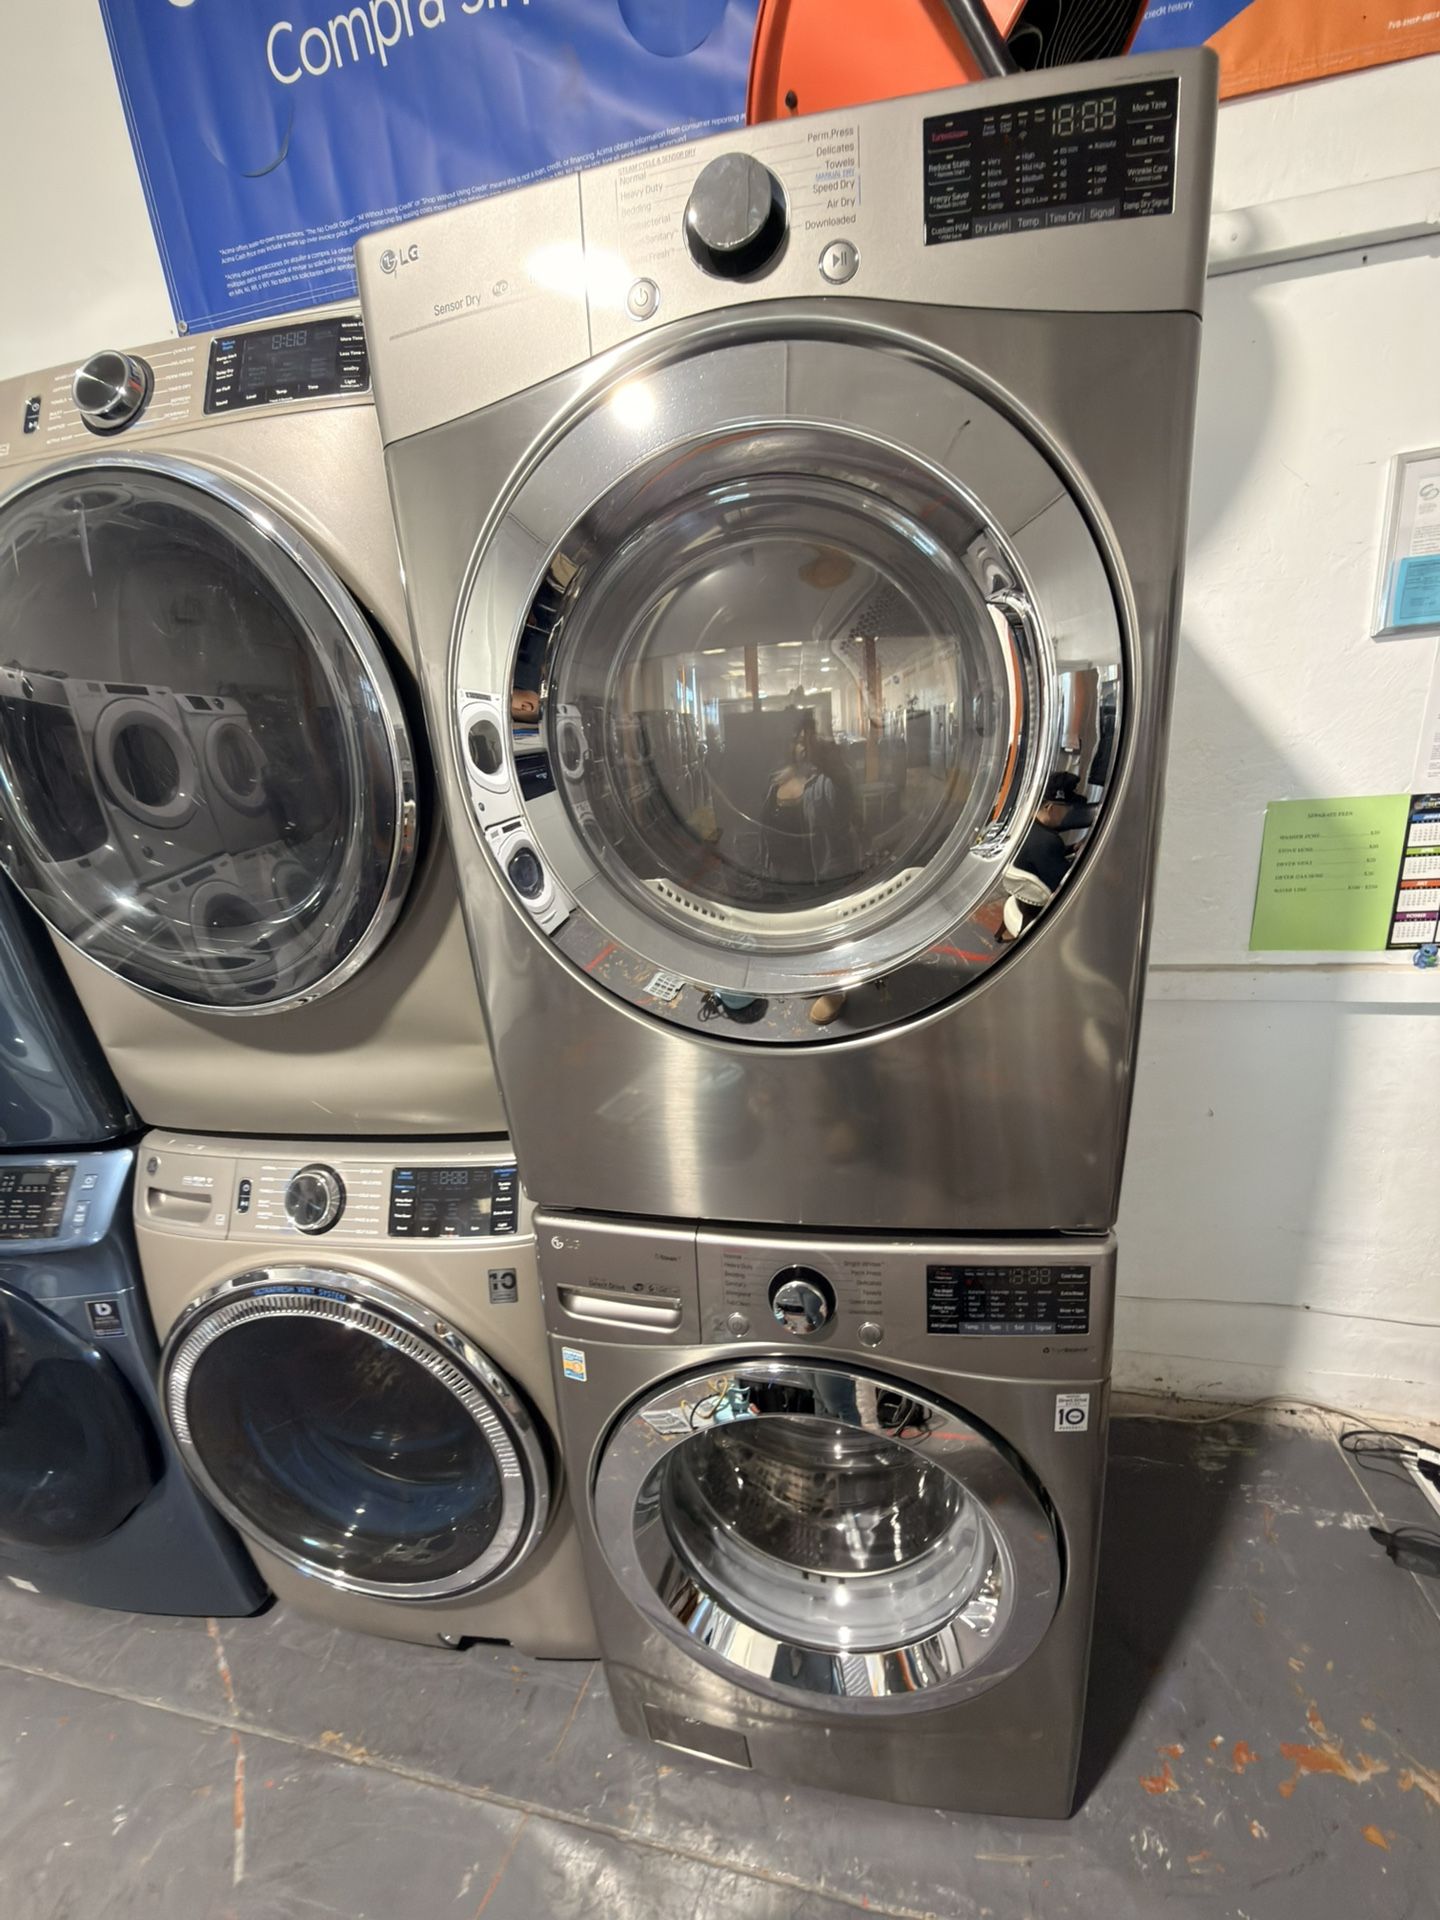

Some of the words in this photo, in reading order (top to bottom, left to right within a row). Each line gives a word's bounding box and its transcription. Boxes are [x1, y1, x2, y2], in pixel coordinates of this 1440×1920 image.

[266, 0, 447, 84] Compra
[1132, 102, 1149, 113] More
[1151, 100, 1168, 110] Time
[634, 128, 666, 148] information
[666, 124, 681, 137] from
[681, 118, 710, 133] consumer
[711, 113, 740, 128] reporting
[807, 127, 854, 142] Perm.Press
[1132, 136, 1148, 146] Less
[1149, 134, 1165, 145] Time
[816, 143, 855, 157] Delicates
[825, 157, 855, 170] Towels
[987, 158, 1001, 166] Very
[1127, 166, 1152, 177] Wrinkle
[1152, 164, 1169, 174] Care
[619, 172, 647, 185] Normal
[620, 188, 645, 201] Heavy
[645, 183, 663, 195] Duty
[813, 180, 839, 194] Speed
[840, 178, 855, 191] Dry
[826, 198, 839, 209] Air
[840, 196, 856, 208] Dry
[929, 194, 952, 205] Energy
[952, 191, 970, 201] Saver
[1050, 213, 1067, 223] Time
[1067, 211, 1082, 222] Dry
[1090, 206, 1115, 219] Signal
[805, 213, 857, 230] Downloaded
[975, 223, 989, 235] Dry
[989, 220, 1009, 231] Level
[1017, 216, 1040, 228] Temp
[931, 225, 954, 236] Custom
[400, 243, 419, 266] LG
[433, 299, 464, 316] Sensor
[465, 294, 482, 309] Dry
[1058, 1408, 1086, 1425] 10
